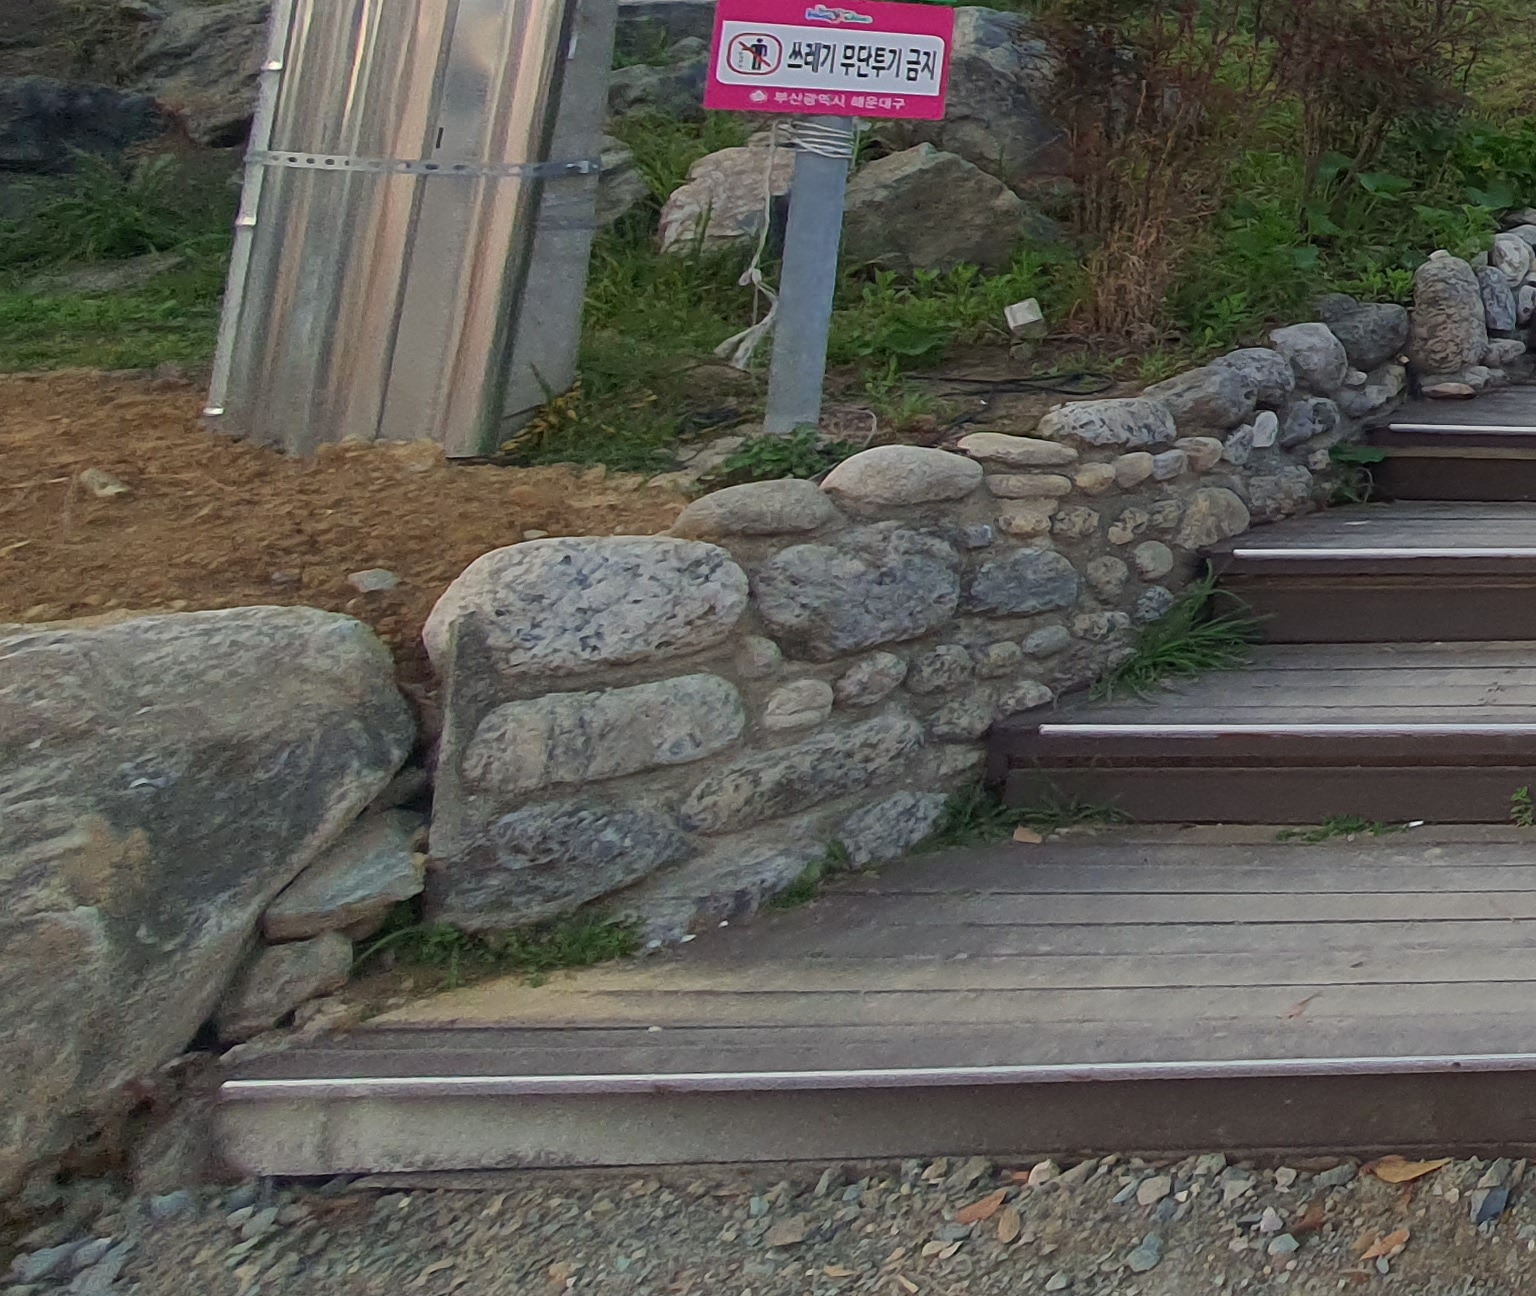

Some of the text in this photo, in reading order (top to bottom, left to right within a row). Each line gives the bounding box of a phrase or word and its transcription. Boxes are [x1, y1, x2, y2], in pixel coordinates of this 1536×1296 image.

[787, 41, 938, 82] 쓰레기 무단투기 금지
[773, 91, 907, 110] 부산광역시 해운대구
